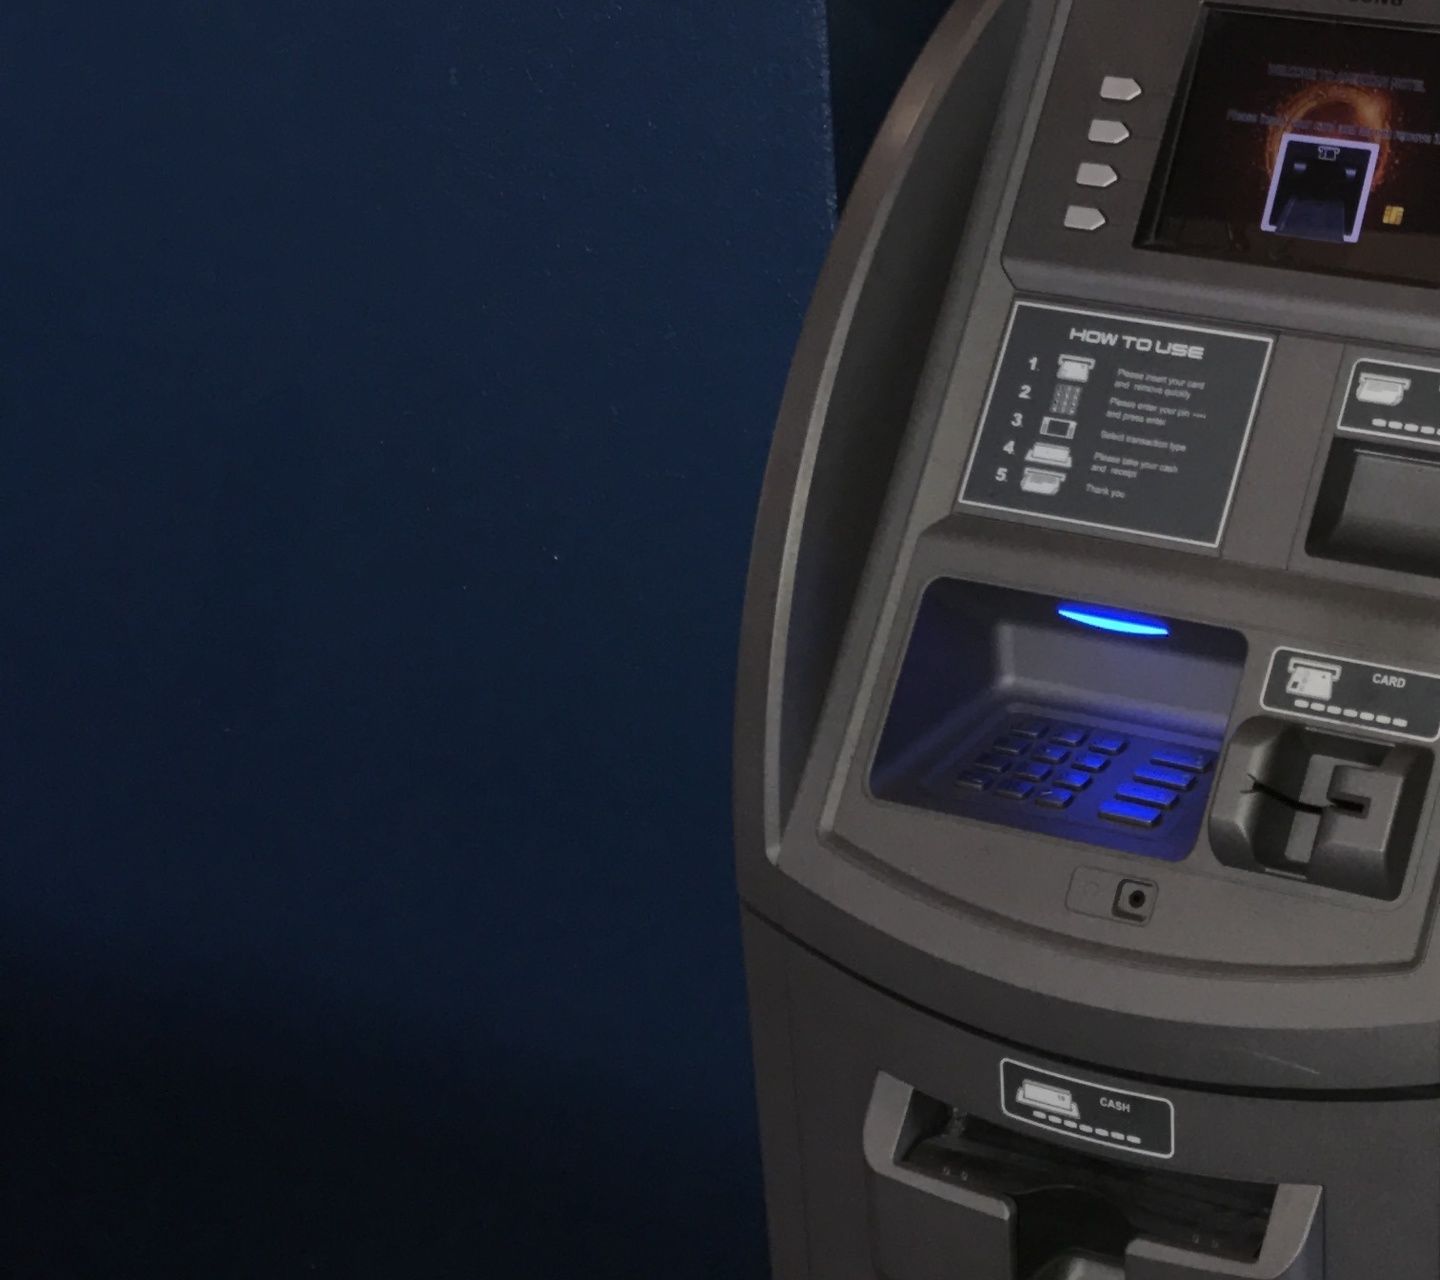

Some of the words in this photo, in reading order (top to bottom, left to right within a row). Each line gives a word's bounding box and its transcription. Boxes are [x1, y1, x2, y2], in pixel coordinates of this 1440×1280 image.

[1069, 327, 1119, 346] HOW
[1121, 335, 1152, 352] TO
[1155, 340, 1205, 360] USE
[1113, 380, 1130, 389] and
[1117, 368, 1144, 381] Please
[1144, 374, 1168, 384] insert
[1168, 378, 1186, 388] your
[1186, 380, 1206, 390] card
[1105, 410, 1121, 419] and
[1109, 396, 1137, 409] Please
[1137, 402, 1158, 412] enter
[1159, 406, 1177, 416] your
[1100, 429, 1125, 442] Select
[1169, 441, 1187, 452] type
[1090, 463, 1107, 473] and
[1093, 451, 1121, 464] Please
[1121, 457, 1140, 468] take
[1140, 461, 1159, 471] your
[1086, 482, 1109, 496] Thank
[1110, 489, 1126, 499] you
[1371, 673, 1407, 689] CARD
[1099, 1097, 1131, 1113] CASH
